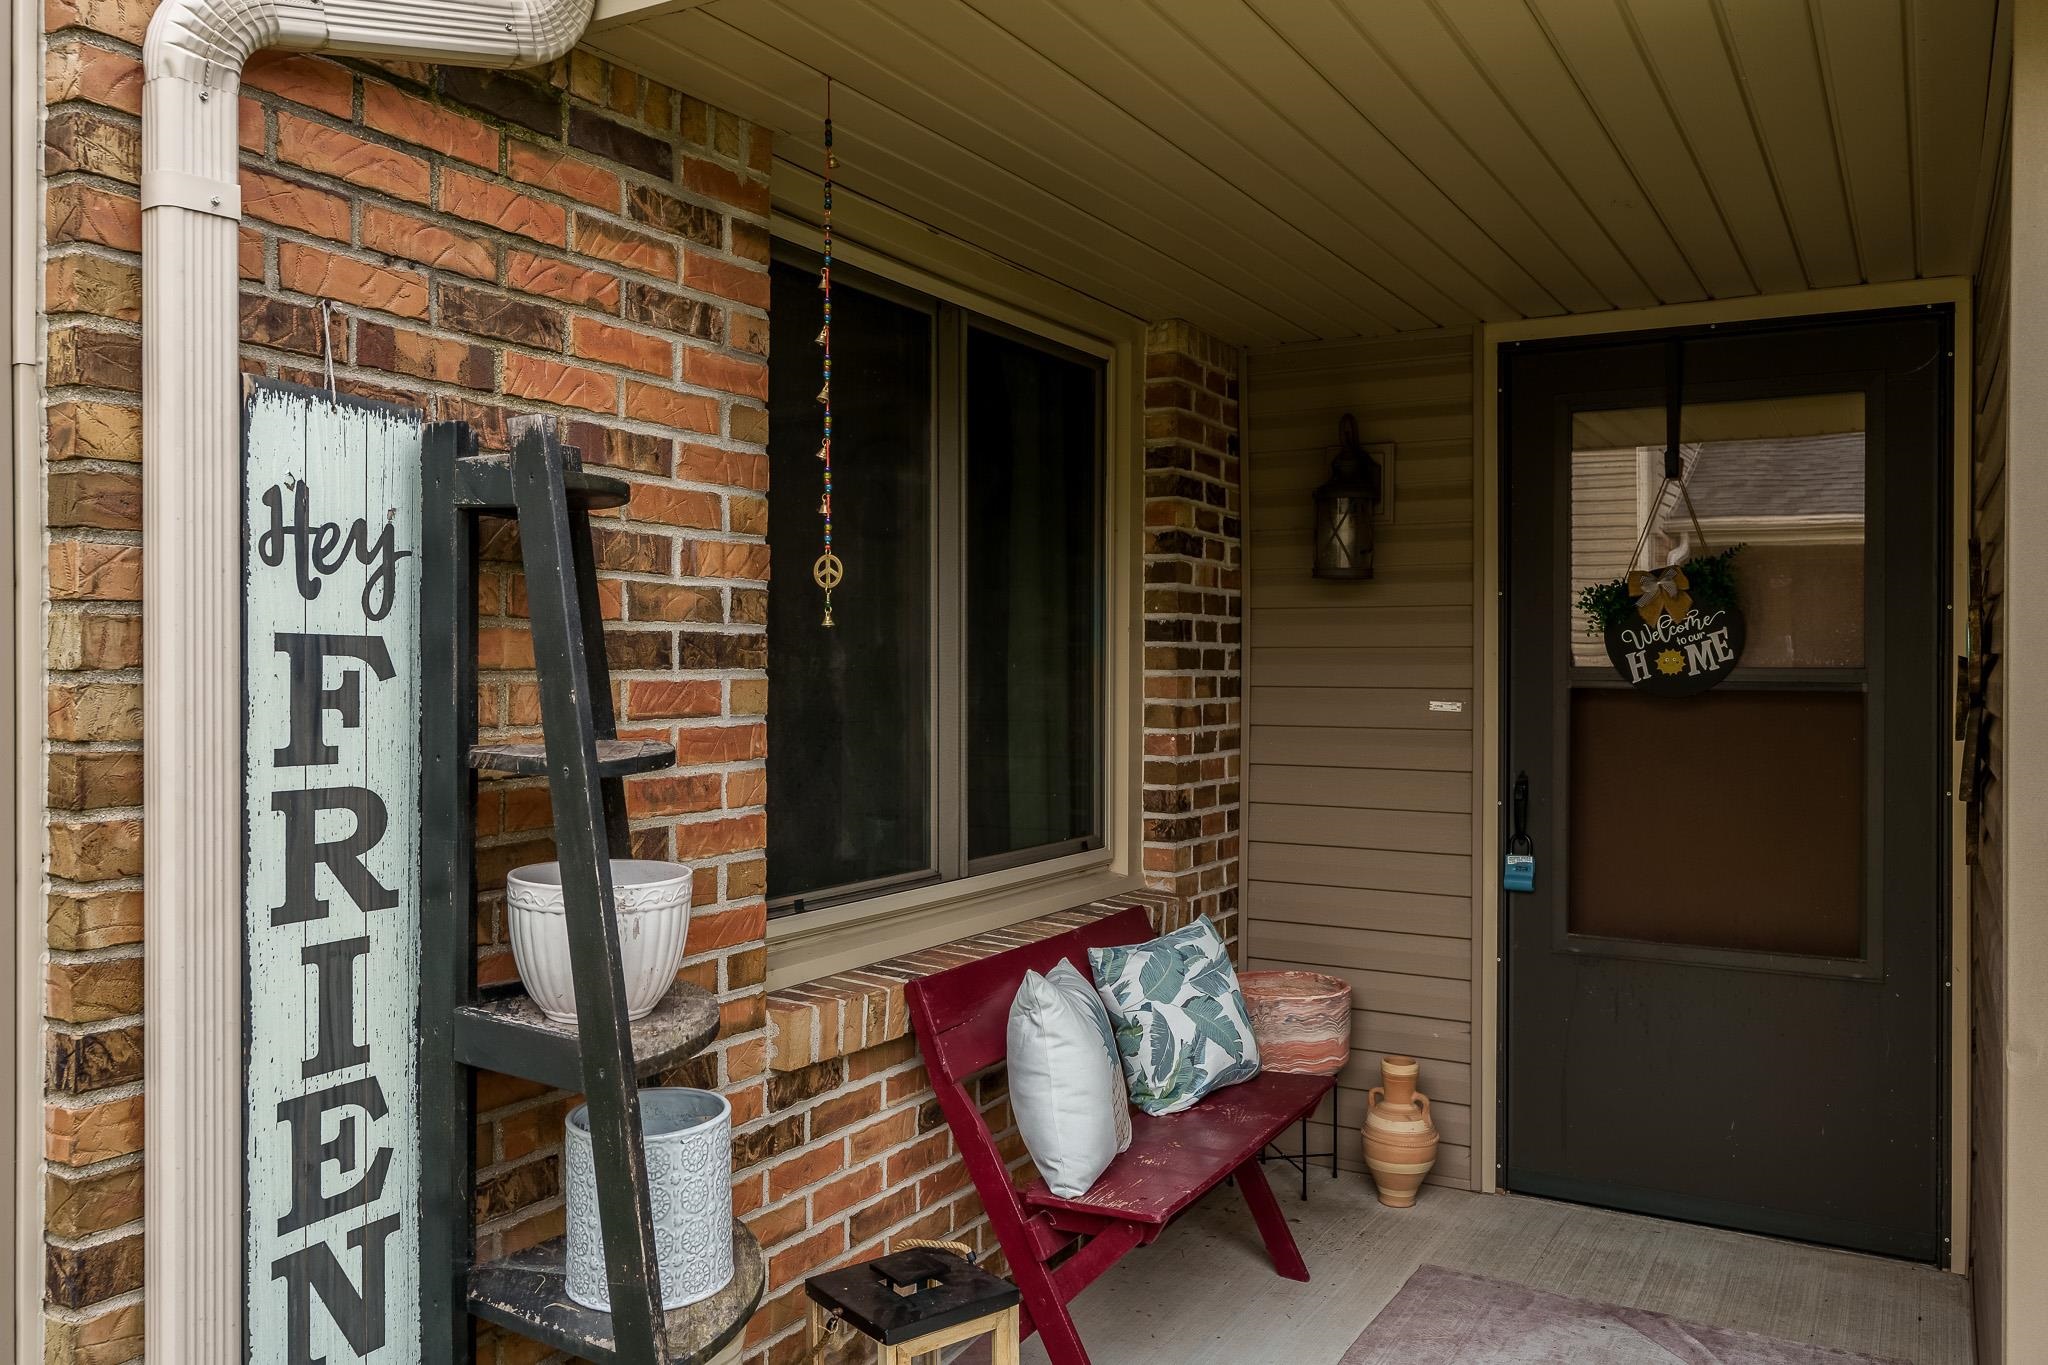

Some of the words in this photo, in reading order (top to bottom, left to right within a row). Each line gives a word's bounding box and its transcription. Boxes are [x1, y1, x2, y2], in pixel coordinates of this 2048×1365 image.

[258, 479, 412, 621] Hey
[1621, 609, 1726, 650] Welcome
[1676, 636, 1687, 645] to
[1688, 631, 1706, 643] our
[1625, 626, 1735, 684] HME
